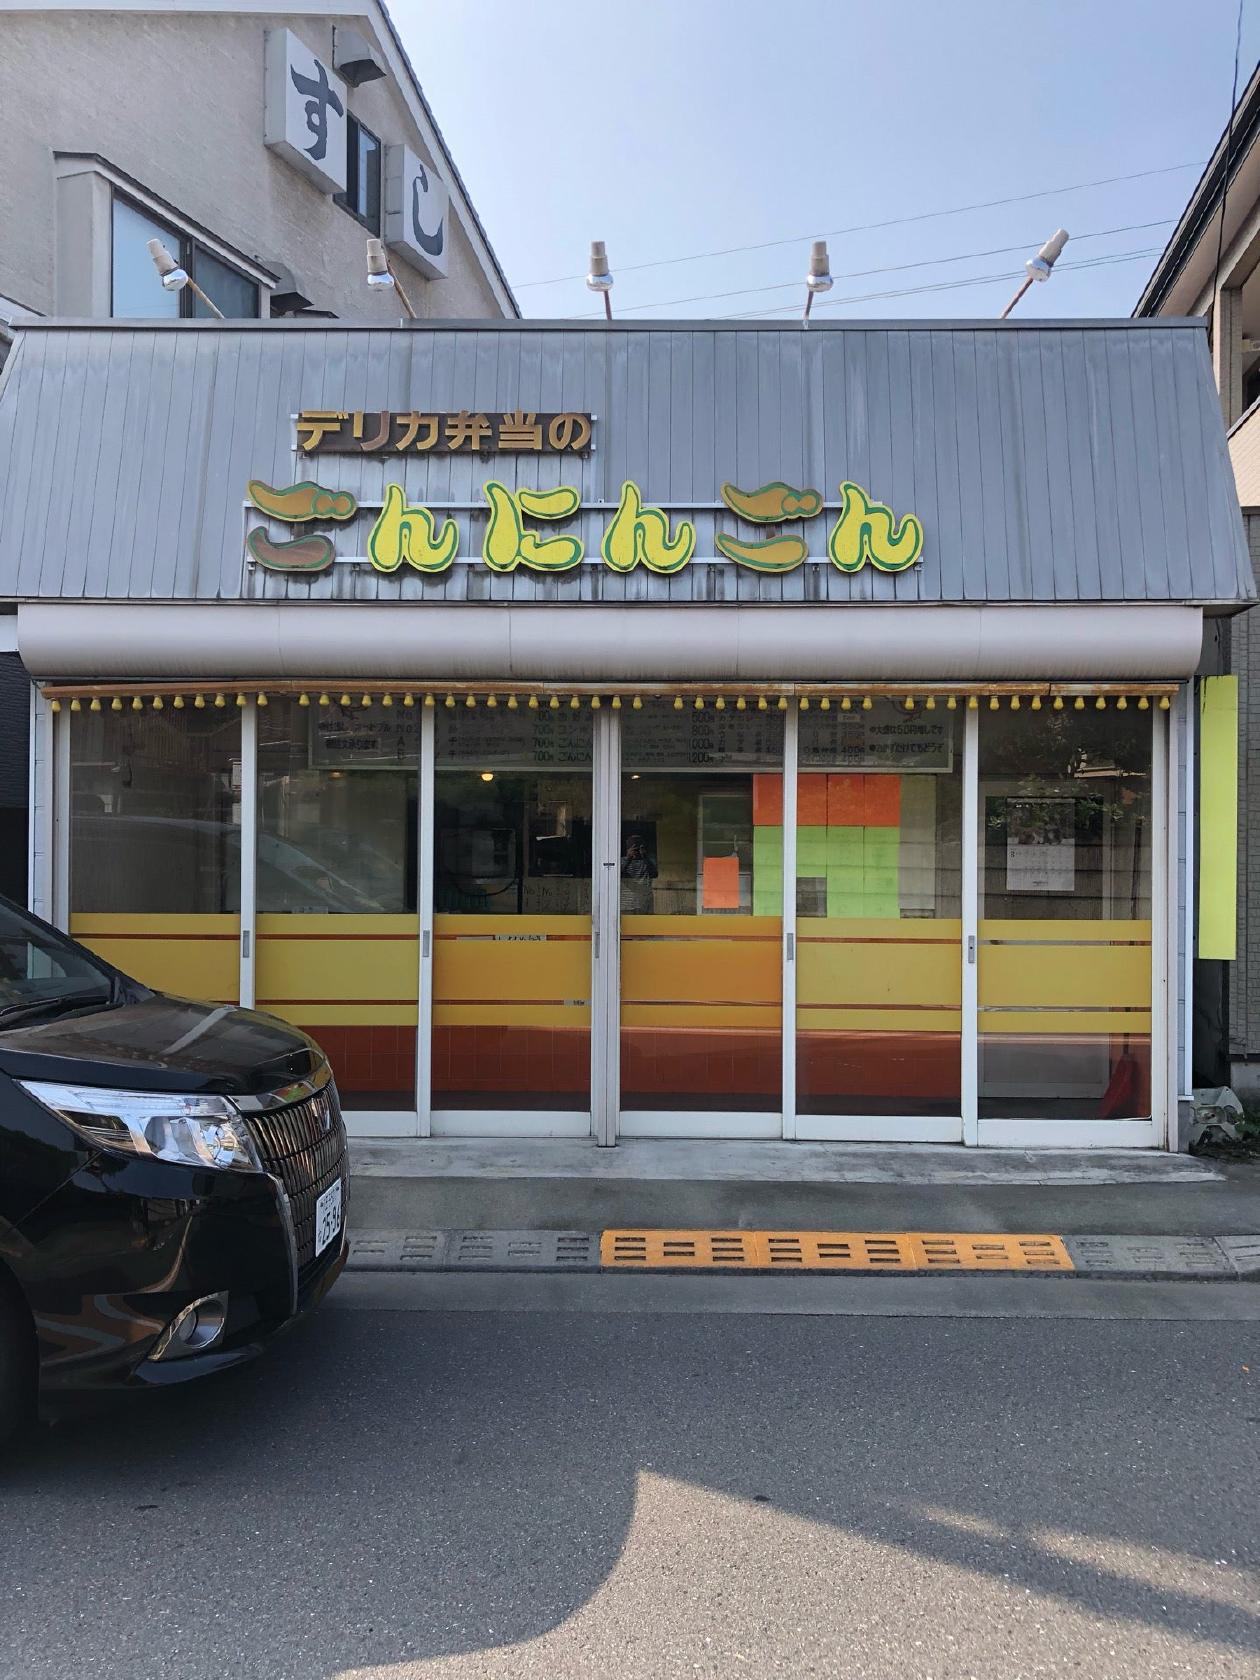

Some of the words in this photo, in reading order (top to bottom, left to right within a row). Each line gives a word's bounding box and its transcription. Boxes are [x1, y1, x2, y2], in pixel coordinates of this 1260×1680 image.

[297, 411, 592, 451] デリカ弁当の
